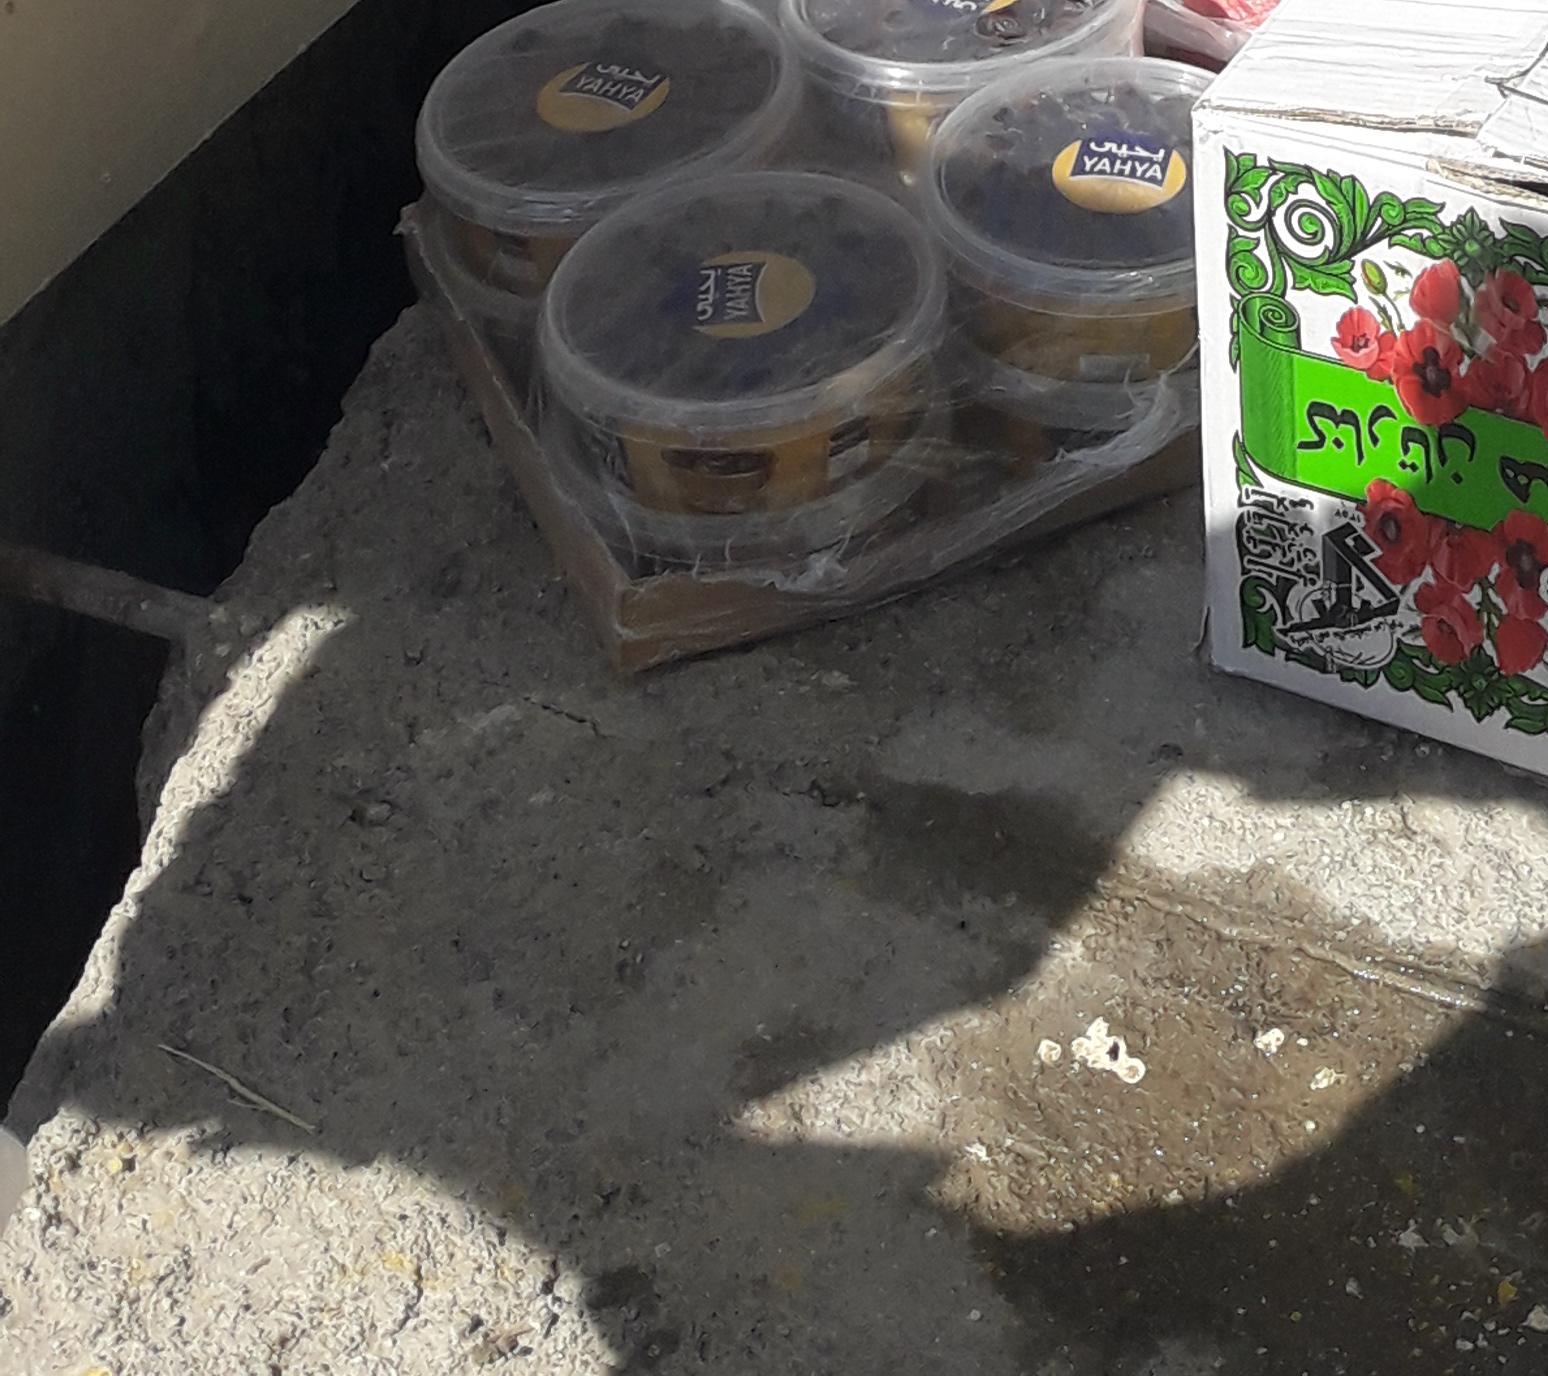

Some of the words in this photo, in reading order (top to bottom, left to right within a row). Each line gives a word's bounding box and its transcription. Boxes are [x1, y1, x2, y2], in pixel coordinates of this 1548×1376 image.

[576, 75, 645, 103] YAHYA
[1083, 154, 1162, 181] YAHYA
[724, 263, 753, 321] YAHYA
